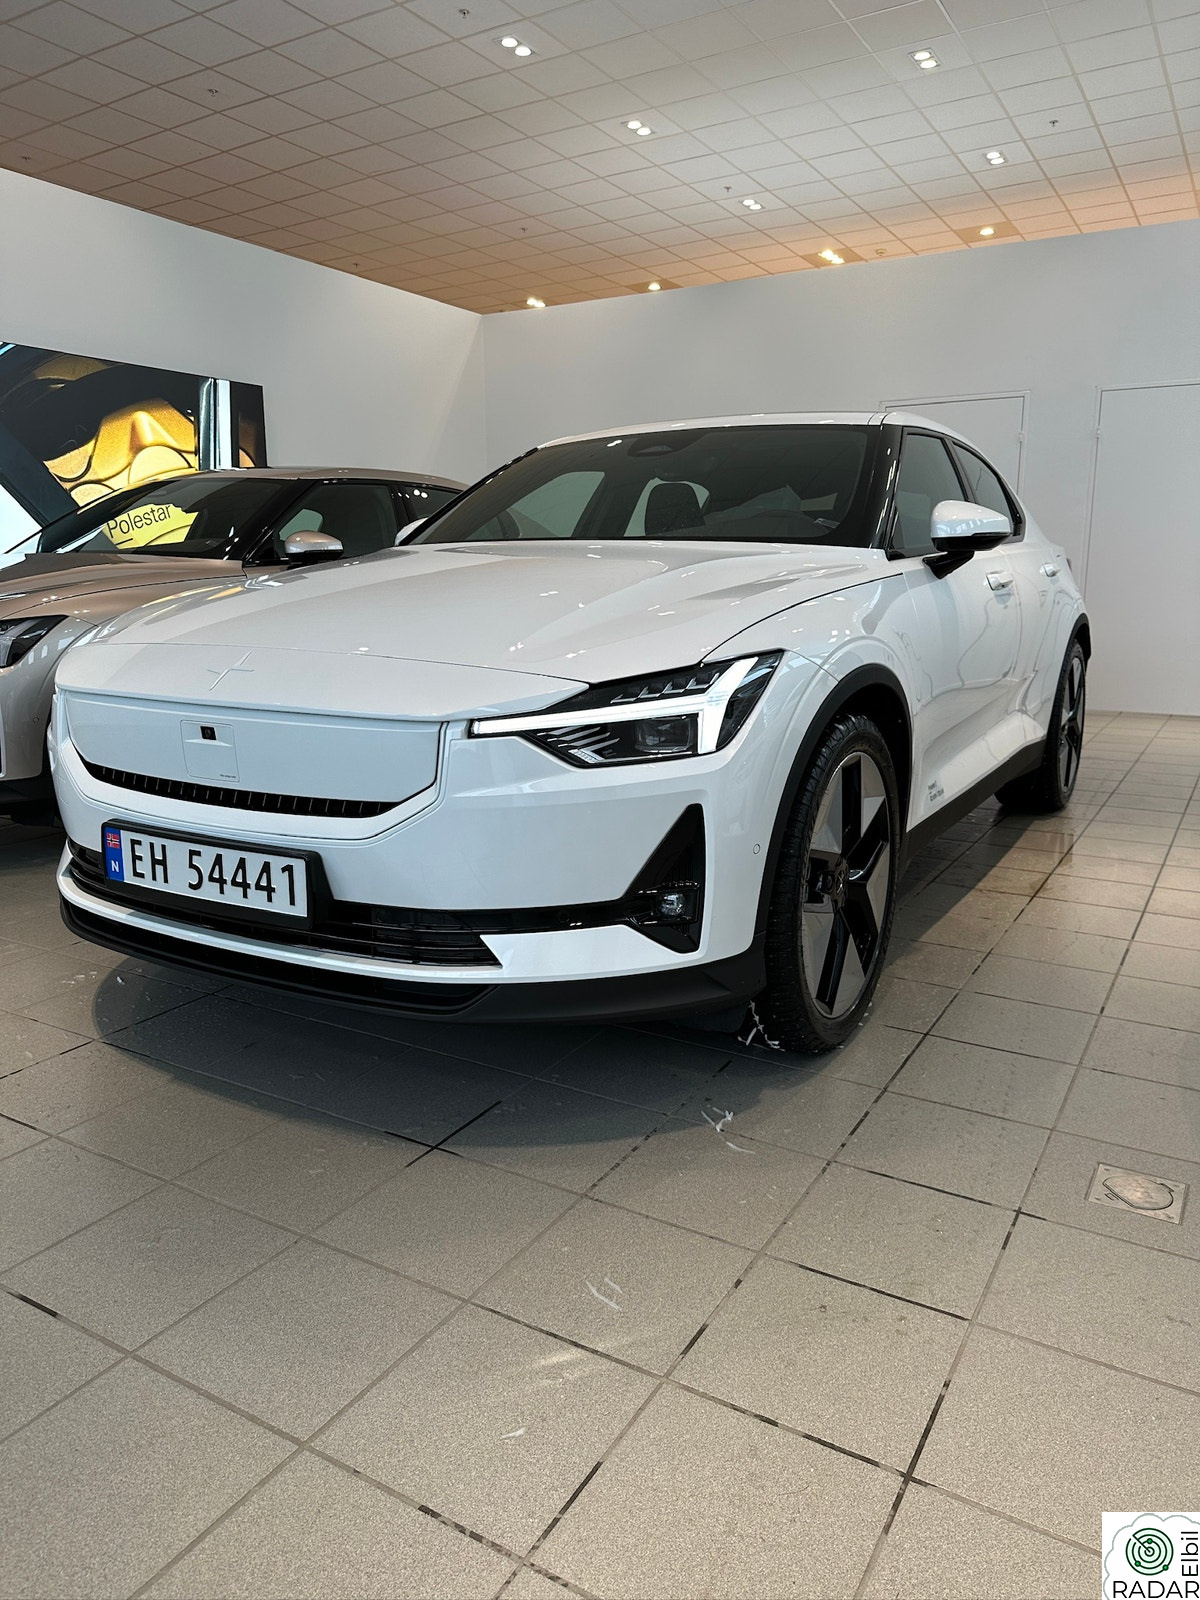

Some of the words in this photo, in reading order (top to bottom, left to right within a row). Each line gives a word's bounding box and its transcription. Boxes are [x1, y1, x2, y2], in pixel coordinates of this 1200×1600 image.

[106, 504, 172, 539] Polestar
[111, 859, 120, 873] N
[130, 838, 169, 884] EH
[188, 848, 296, 907] 54441
